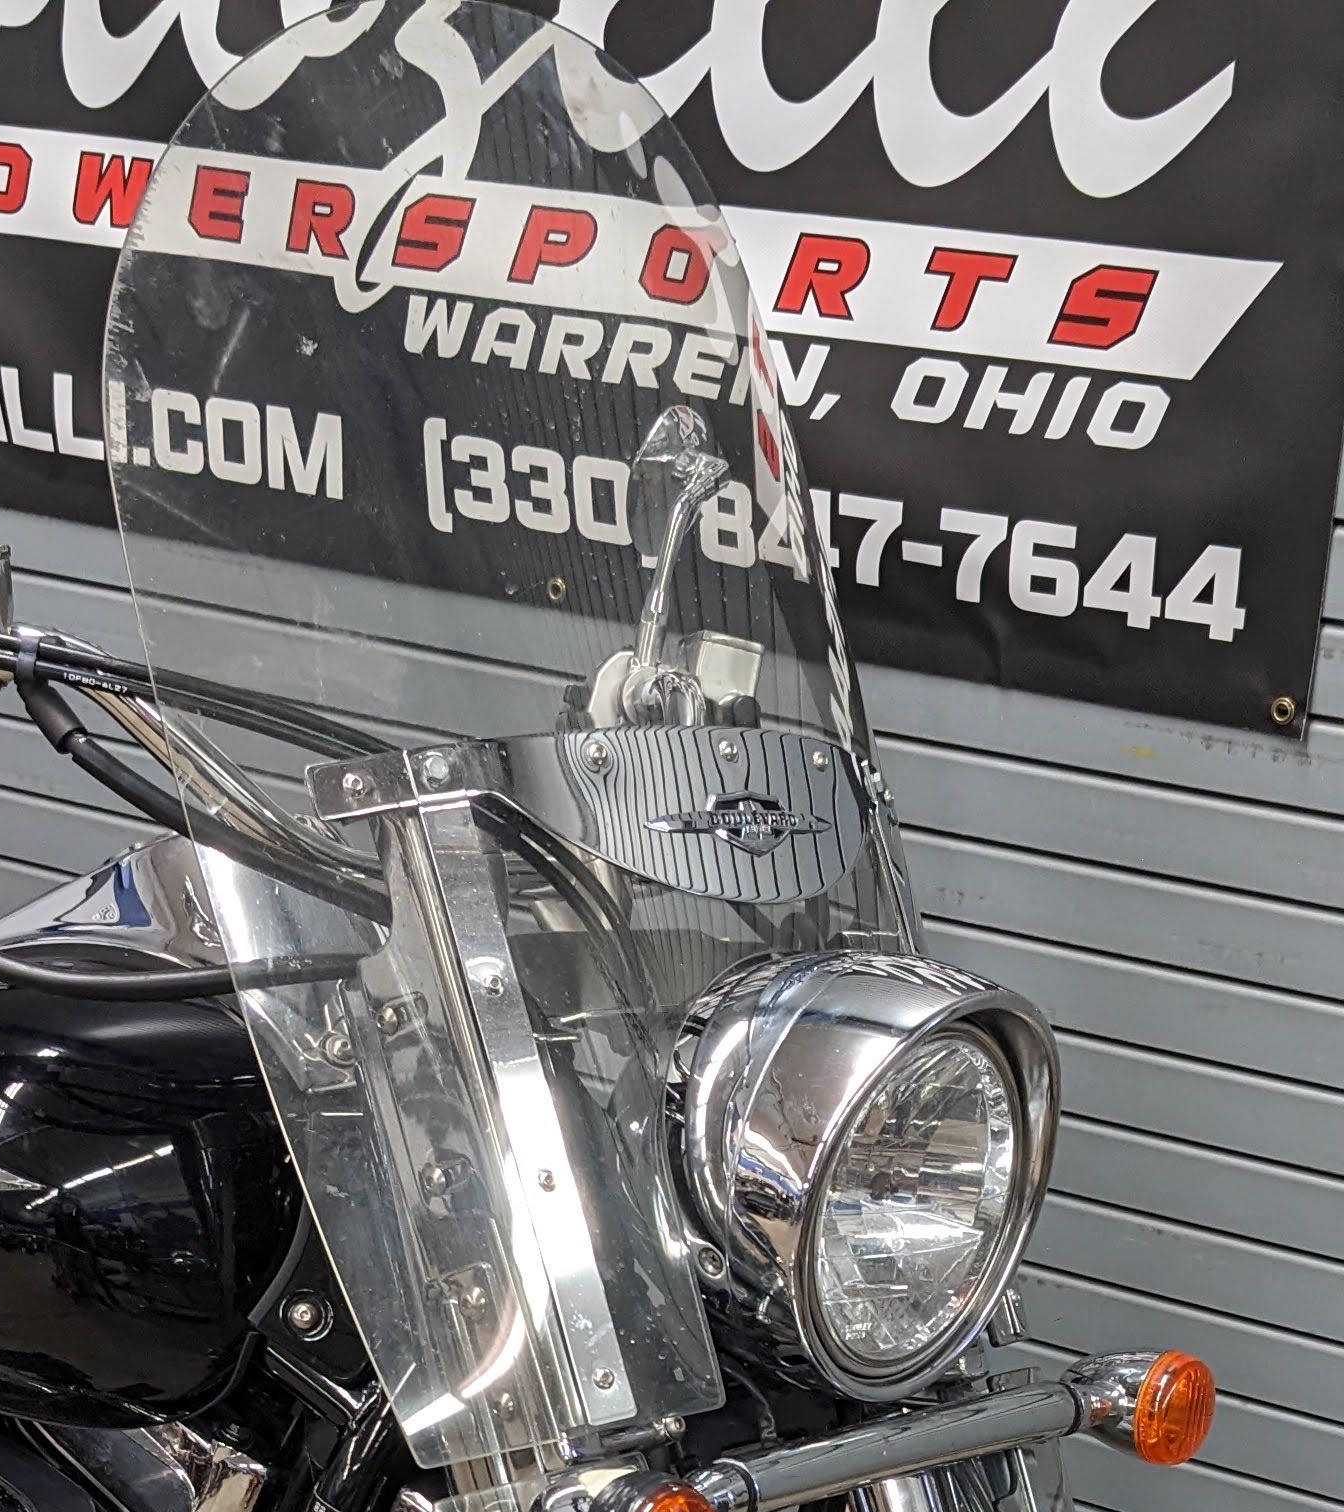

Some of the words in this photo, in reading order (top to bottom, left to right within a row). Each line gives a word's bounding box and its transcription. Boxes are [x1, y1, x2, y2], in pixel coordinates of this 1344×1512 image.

[404, 294, 840, 421] WARREN,
[890, 356, 1171, 461] OHIO
[700, 480, 1246, 642] 847-7644
[708, 811, 799, 828] BOULEVARD
